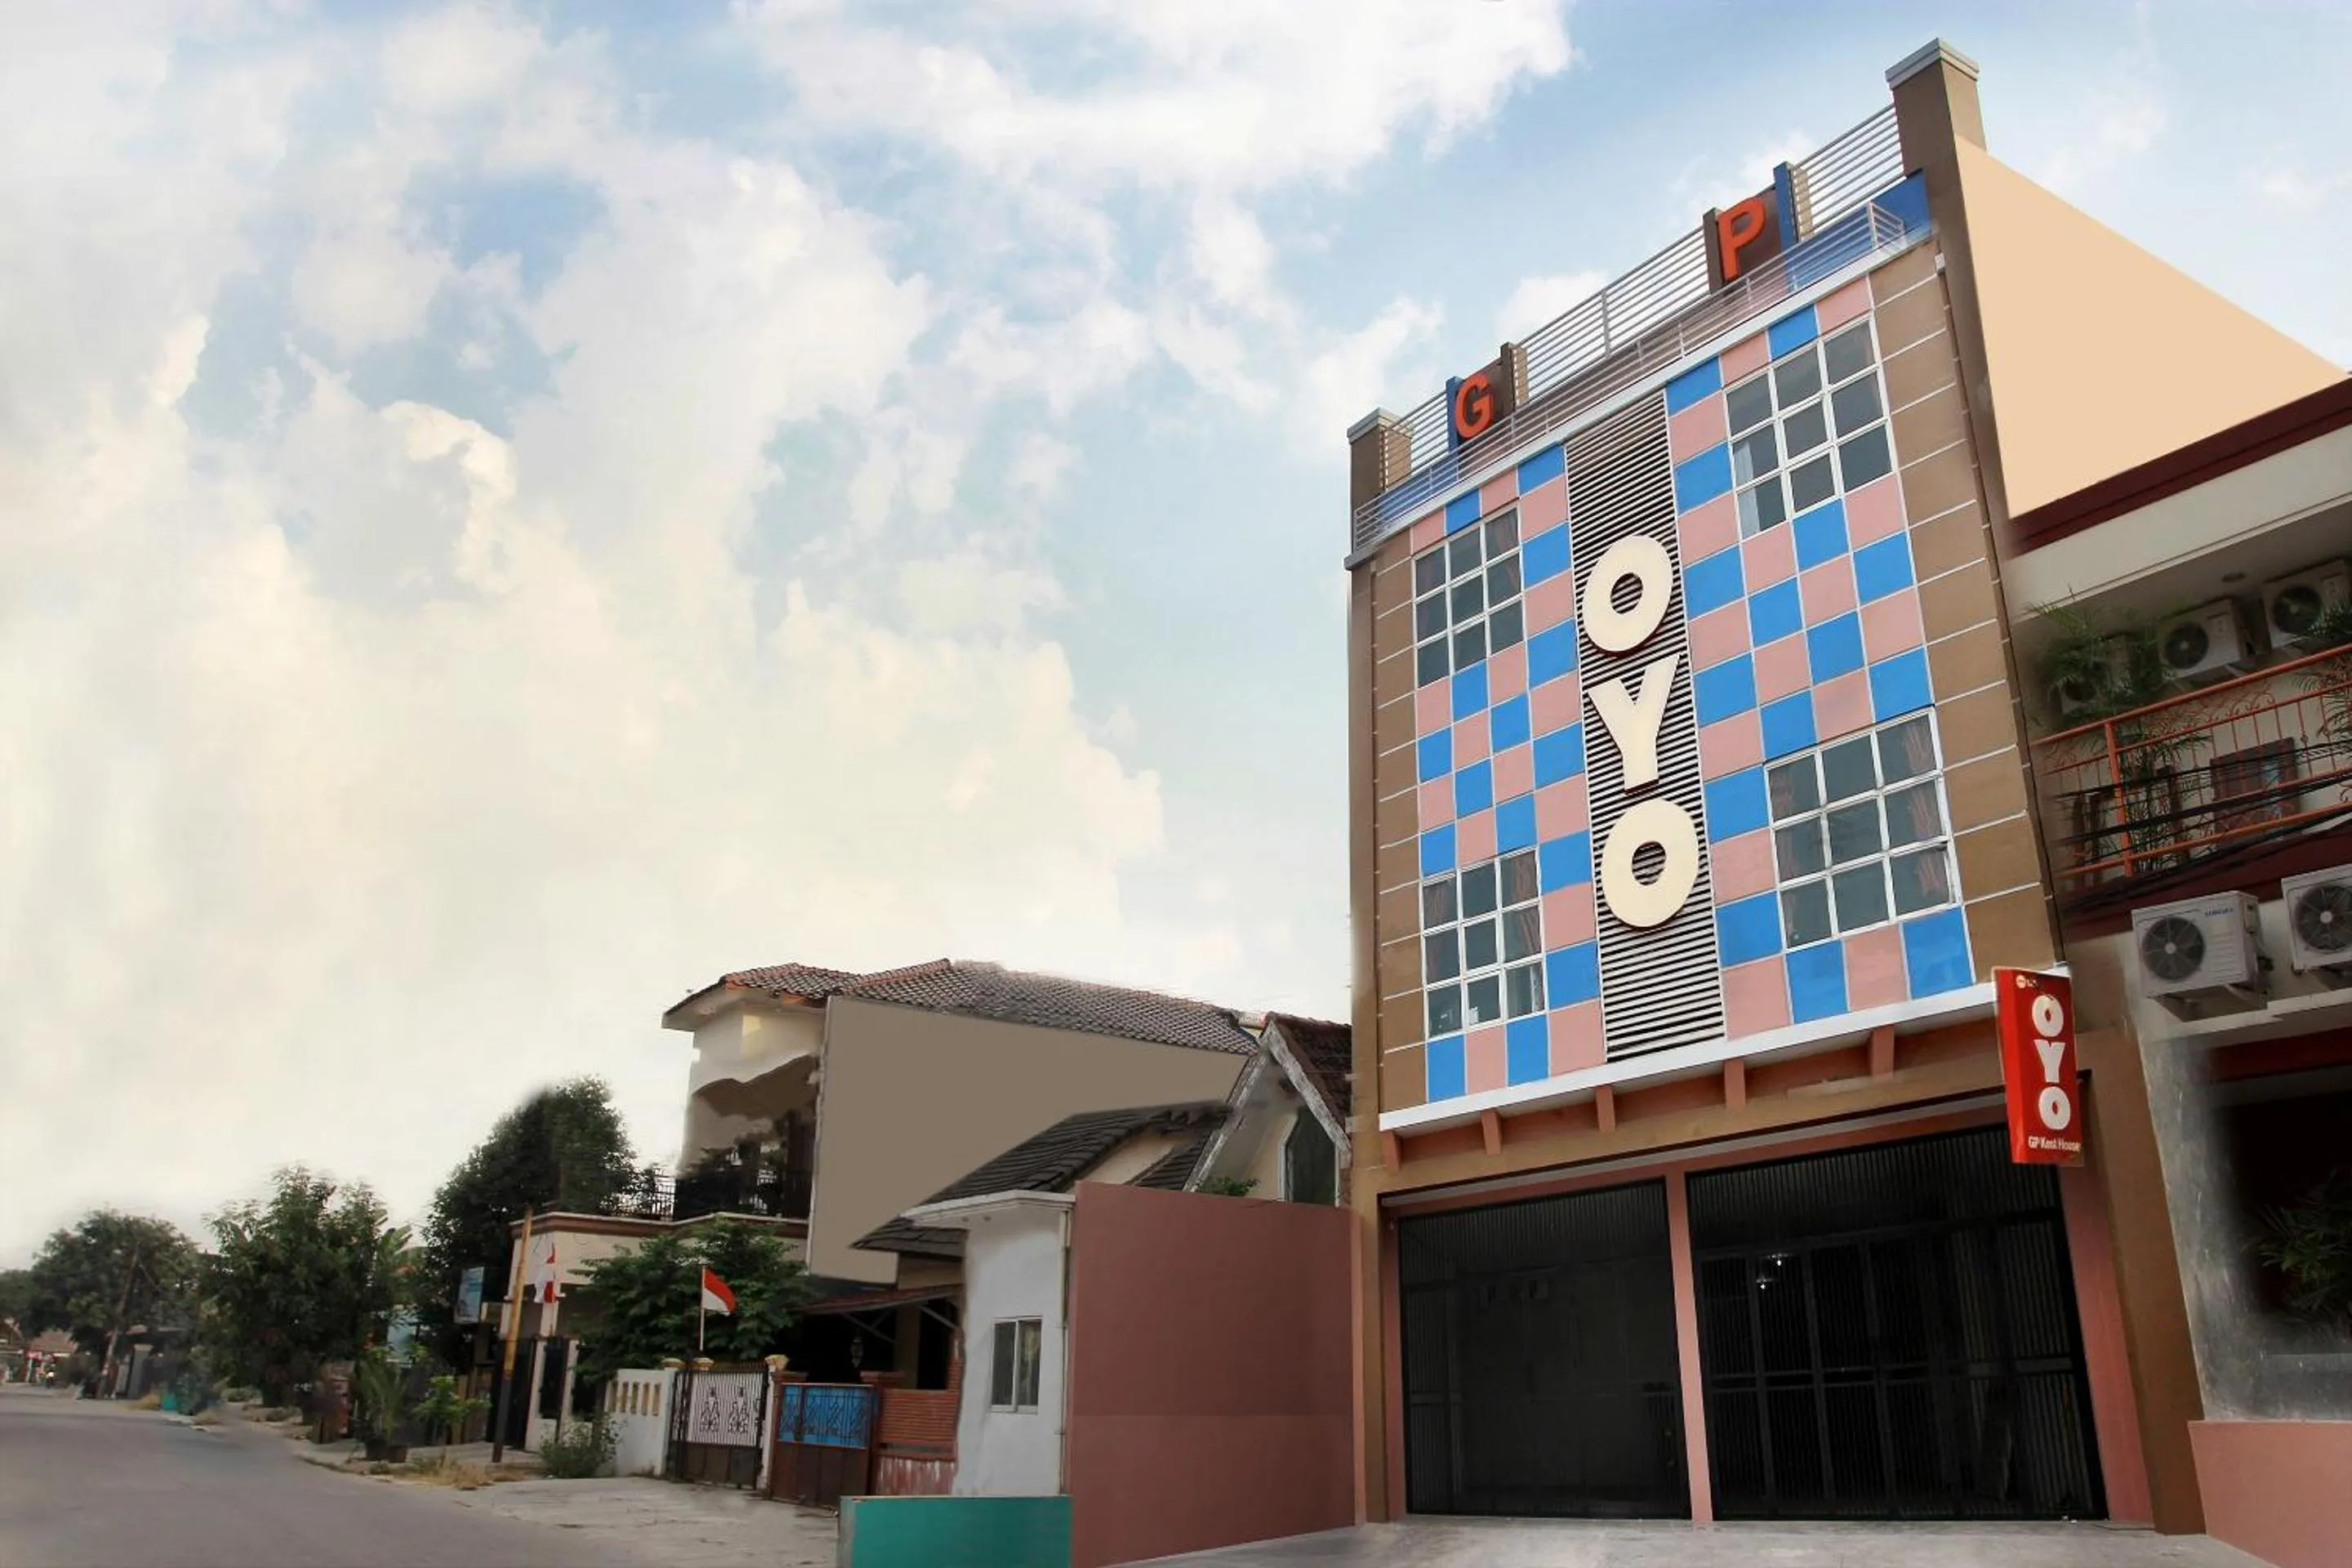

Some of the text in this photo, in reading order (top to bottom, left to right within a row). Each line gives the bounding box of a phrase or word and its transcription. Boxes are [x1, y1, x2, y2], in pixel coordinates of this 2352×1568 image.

[1455, 197, 1766, 439] G P
[1583, 535, 1699, 928] OYO
[2029, 1136, 2040, 1149] GP
[2032, 995, 2071, 1130] OYO
